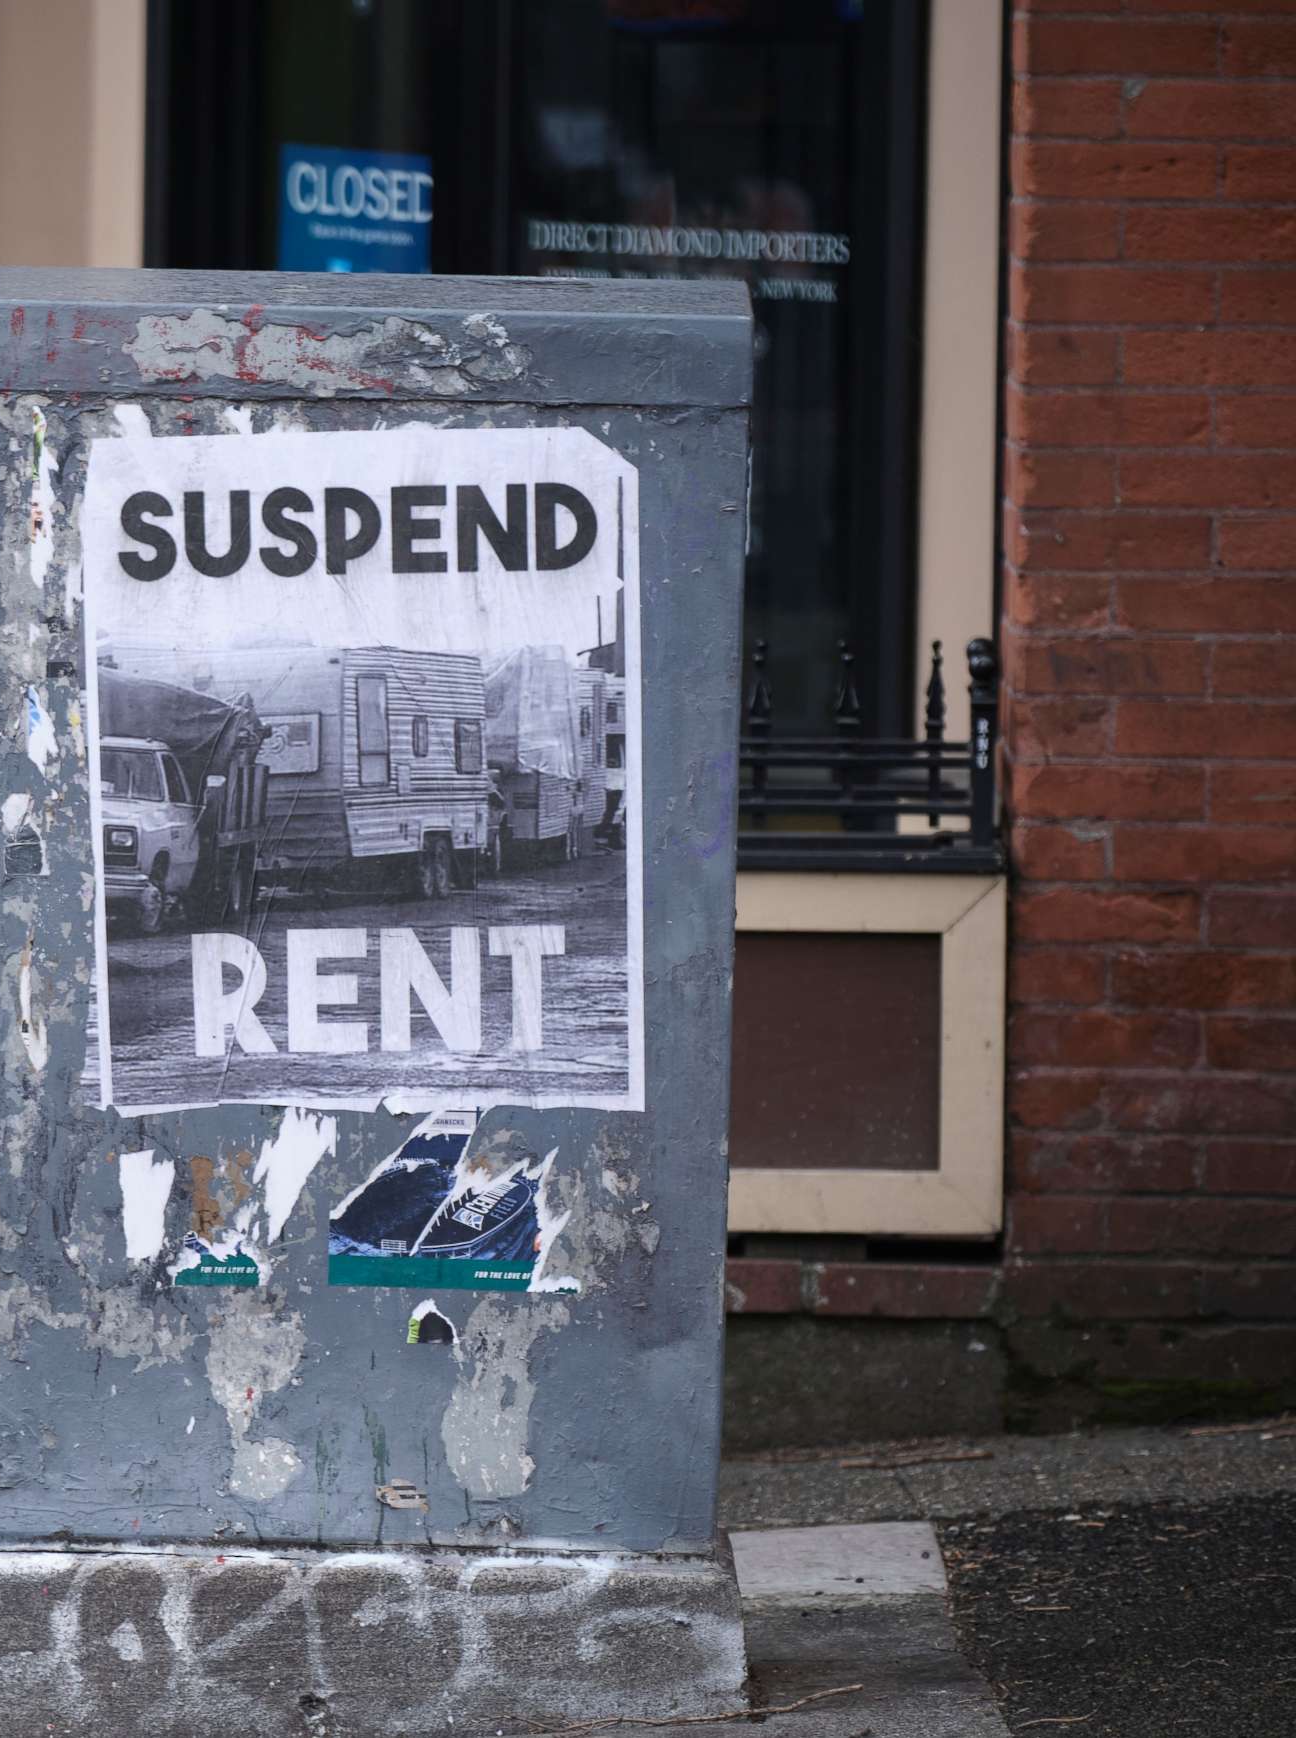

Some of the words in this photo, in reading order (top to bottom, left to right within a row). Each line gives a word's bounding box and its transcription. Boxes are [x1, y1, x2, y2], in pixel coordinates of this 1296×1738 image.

[287, 161, 433, 222] CLOSED
[531, 221, 612, 252] DIRECT
[615, 225, 723, 257] DIAMOND
[724, 229, 850, 263] IMPORTERS
[762, 278, 800, 299] NEW
[801, 281, 838, 302] YORK
[118, 483, 597, 581] SUSPEND
[191, 926, 565, 1056] RENT
[522, 1272, 532, 1280] OF
